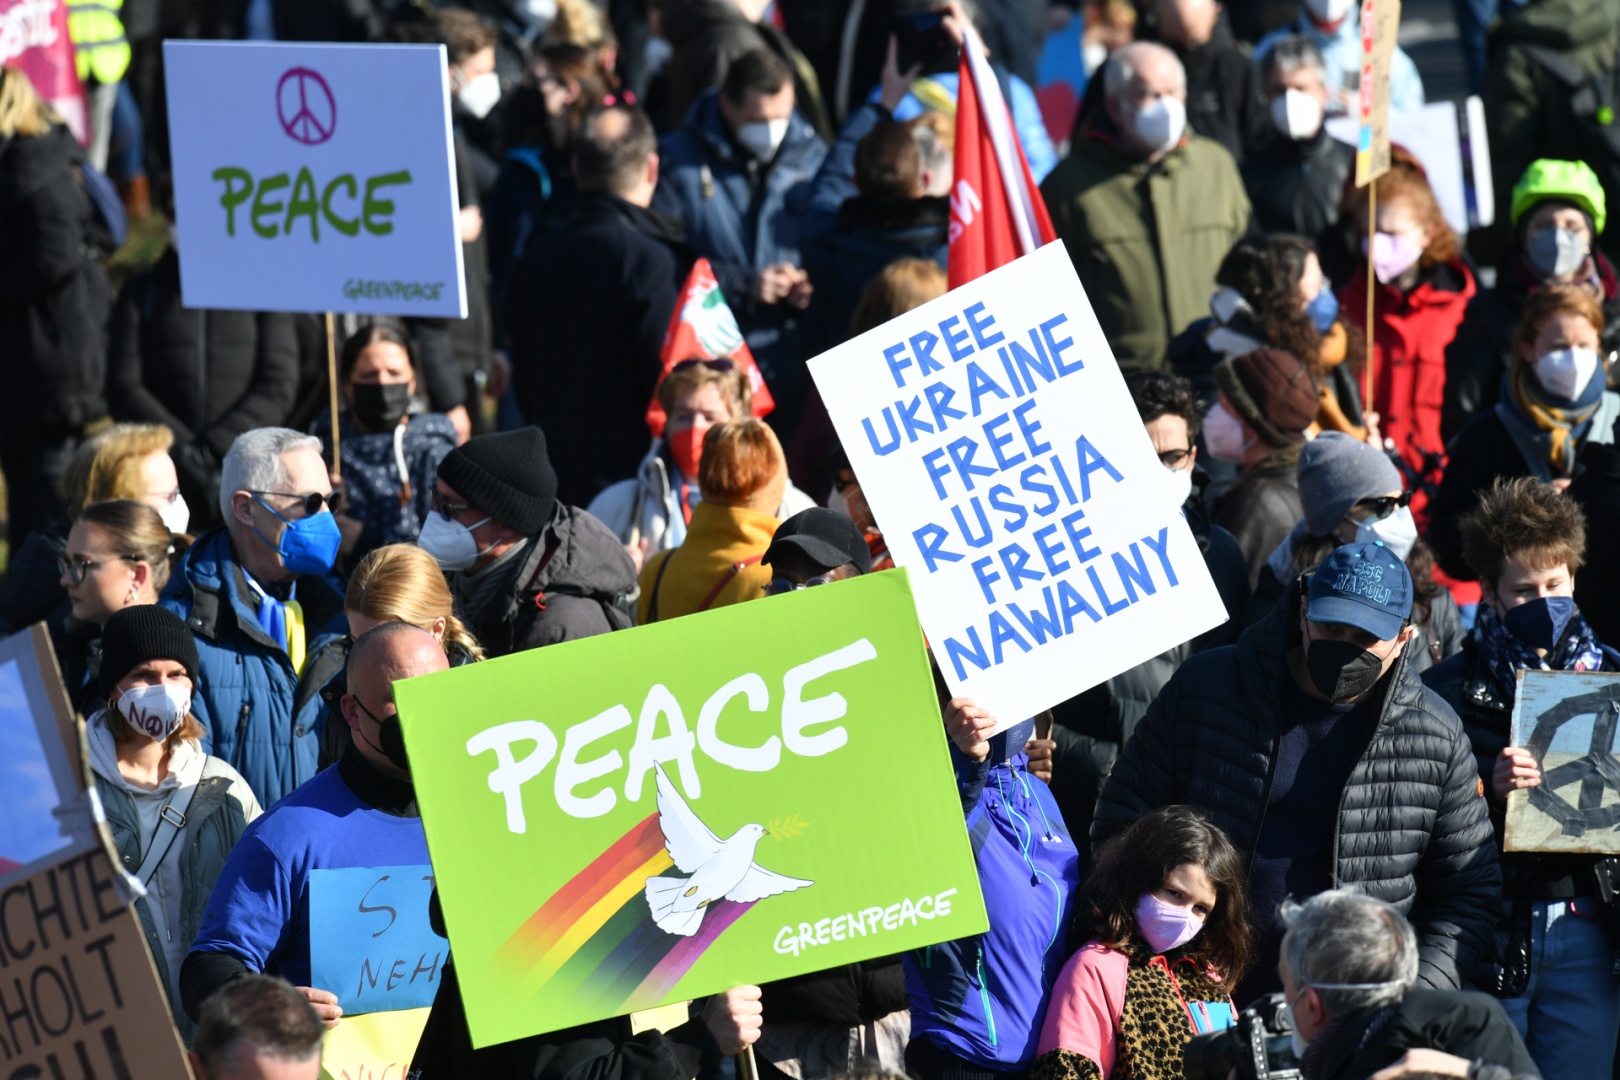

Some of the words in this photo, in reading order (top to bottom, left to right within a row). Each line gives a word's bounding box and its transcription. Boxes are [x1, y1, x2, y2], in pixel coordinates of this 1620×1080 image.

[212, 166, 412, 243] PEACE
[342, 278, 446, 302] GREENPEACE
[861, 312, 1085, 457] UKRAINE
[883, 301, 1005, 388] FREE
[922, 398, 1052, 501] FREE
[912, 434, 1125, 573] RUSSIA
[971, 509, 1102, 605] FREE
[1332, 573, 1392, 606] NAPOLI
[1354, 560, 1384, 583] SSC
[943, 526, 1180, 682] NAWALNY
[466, 638, 878, 834] PEACE
[773, 888, 958, 956] GREENPEACE
